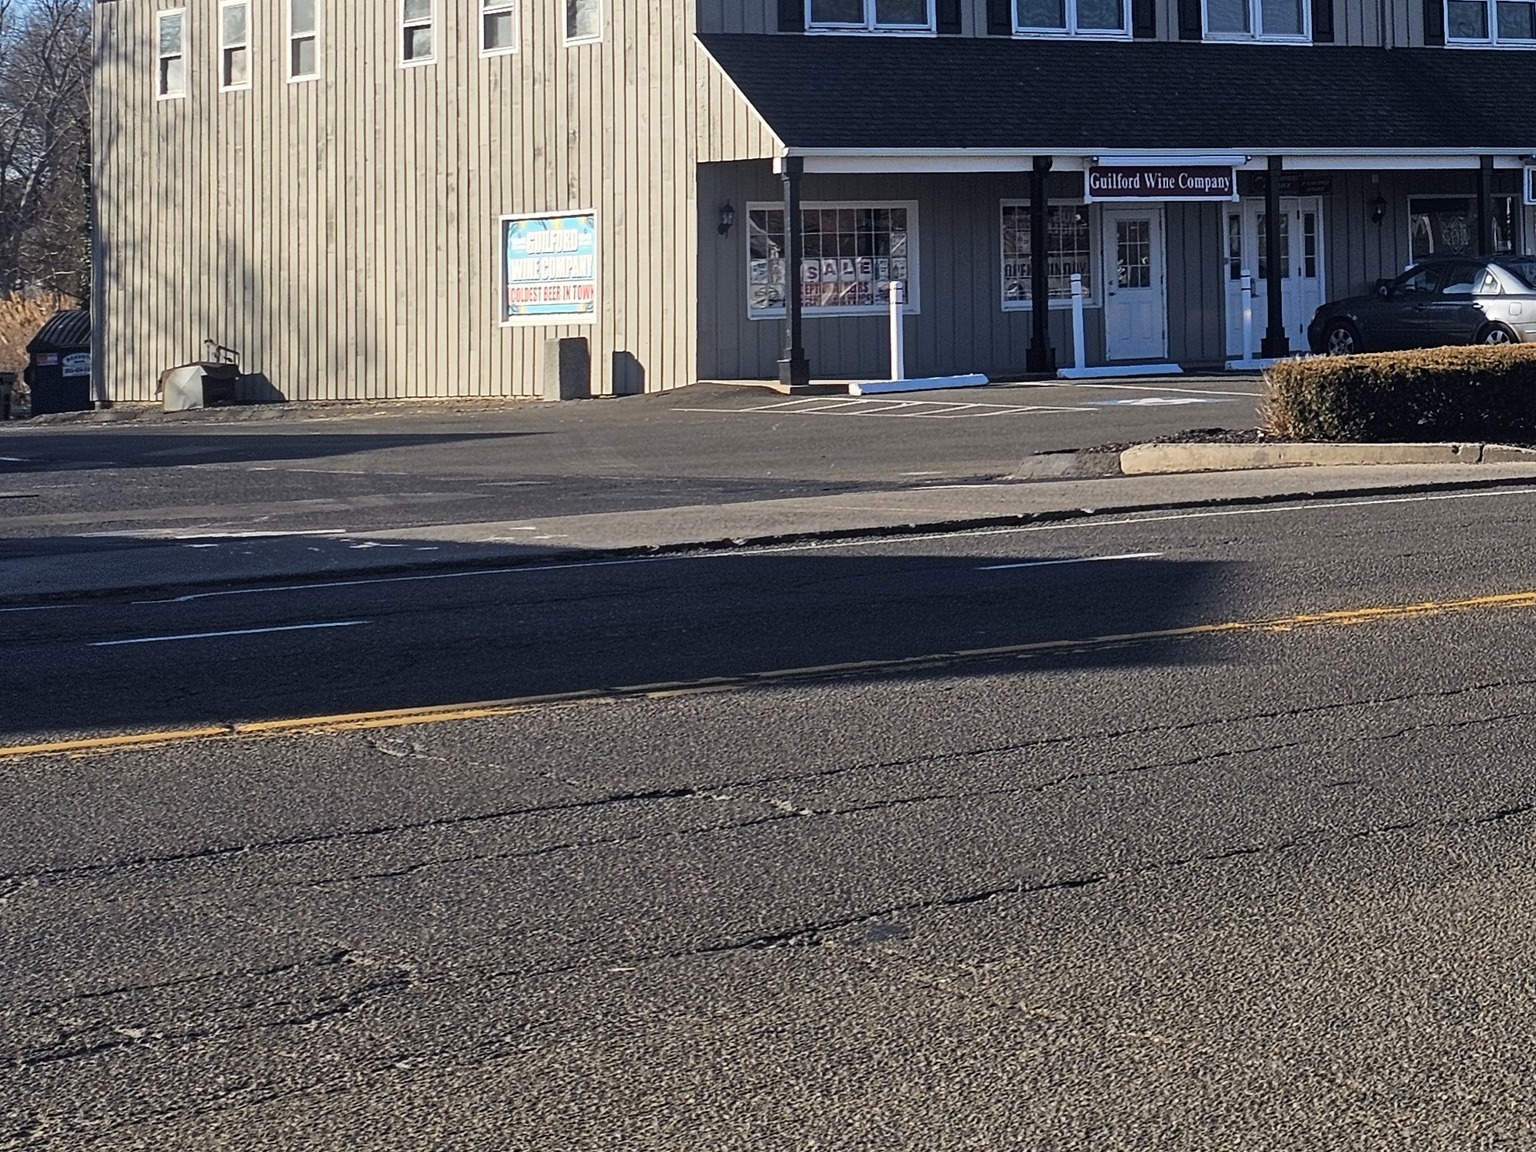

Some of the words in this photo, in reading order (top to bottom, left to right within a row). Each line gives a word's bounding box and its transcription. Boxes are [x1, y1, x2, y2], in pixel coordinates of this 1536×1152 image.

[1090, 172, 1140, 189] Guilford
[1144, 172, 1175, 189] Wine
[1178, 172, 1231, 192] Company
[526, 229, 579, 255] GUILFORD
[511, 257, 541, 282] WINE
[541, 254, 594, 280] COMPANY
[807, 261, 871, 280] SALE
[510, 286, 542, 303] COLDEST
[543, 285, 561, 302] BEER
